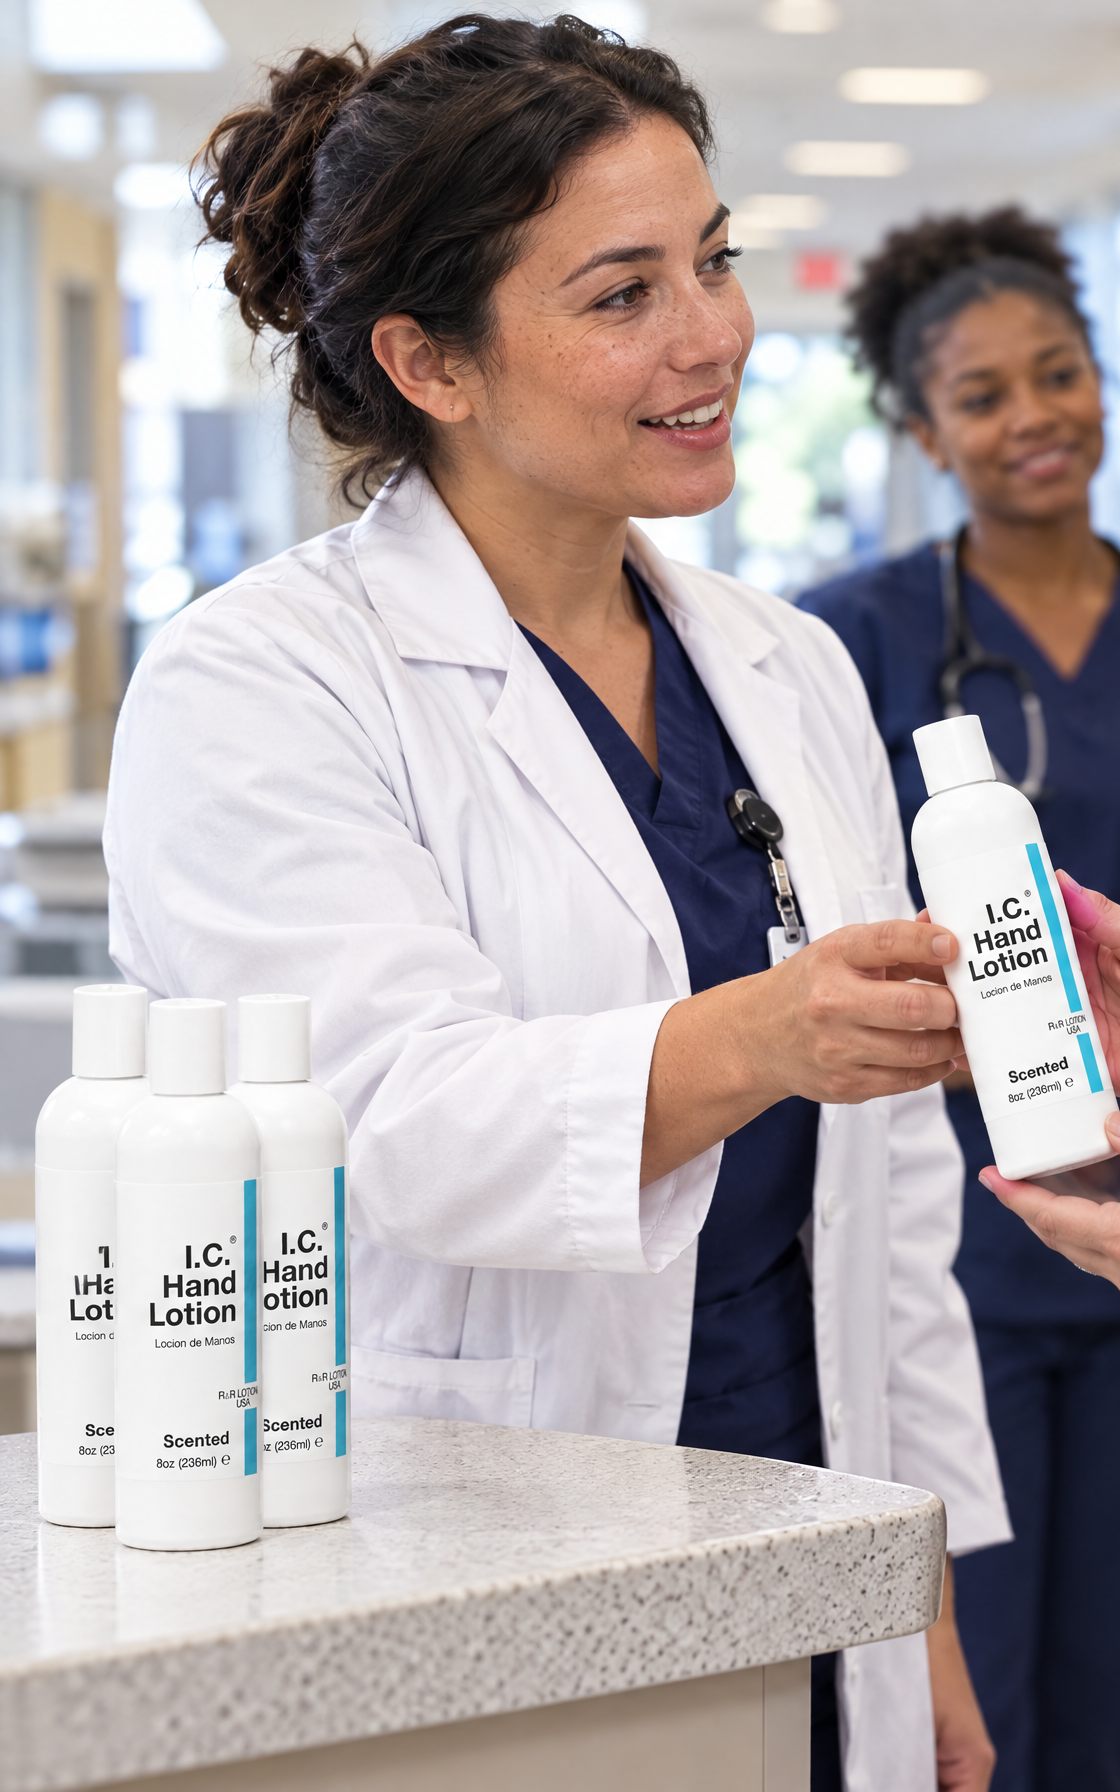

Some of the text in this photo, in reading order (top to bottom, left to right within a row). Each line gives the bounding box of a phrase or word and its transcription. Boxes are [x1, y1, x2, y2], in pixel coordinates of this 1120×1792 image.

[973, 918, 1042, 954] Hand
[968, 946, 1048, 982] Lotion
[980, 974, 1053, 1000] Locion de Manos
[1008, 1056, 1069, 1083] Scented
[1008, 1092, 1025, 1103] 8oz
[1027, 1081, 1062, 1100] (236ml)
[262, 1254, 328, 1284] Hand
[164, 1268, 236, 1298] Hand
[262, 1285, 328, 1311] otion
[70, 1299, 114, 1321] Lot
[150, 1301, 236, 1326] Lotion
[76, 1332, 106, 1340] Locion
[262, 1320, 327, 1331] cion de Manos
[155, 1337, 235, 1348] Locion de Manos
[236, 1398, 251, 1408] USA
[263, 1414, 322, 1432] Scented
[79, 1446, 97, 1455] 8oz
[164, 1431, 229, 1448] Scented
[275, 1438, 310, 1453] (236ml)
[157, 1458, 175, 1468] 8oz
[179, 1456, 217, 1470] (236ml)
